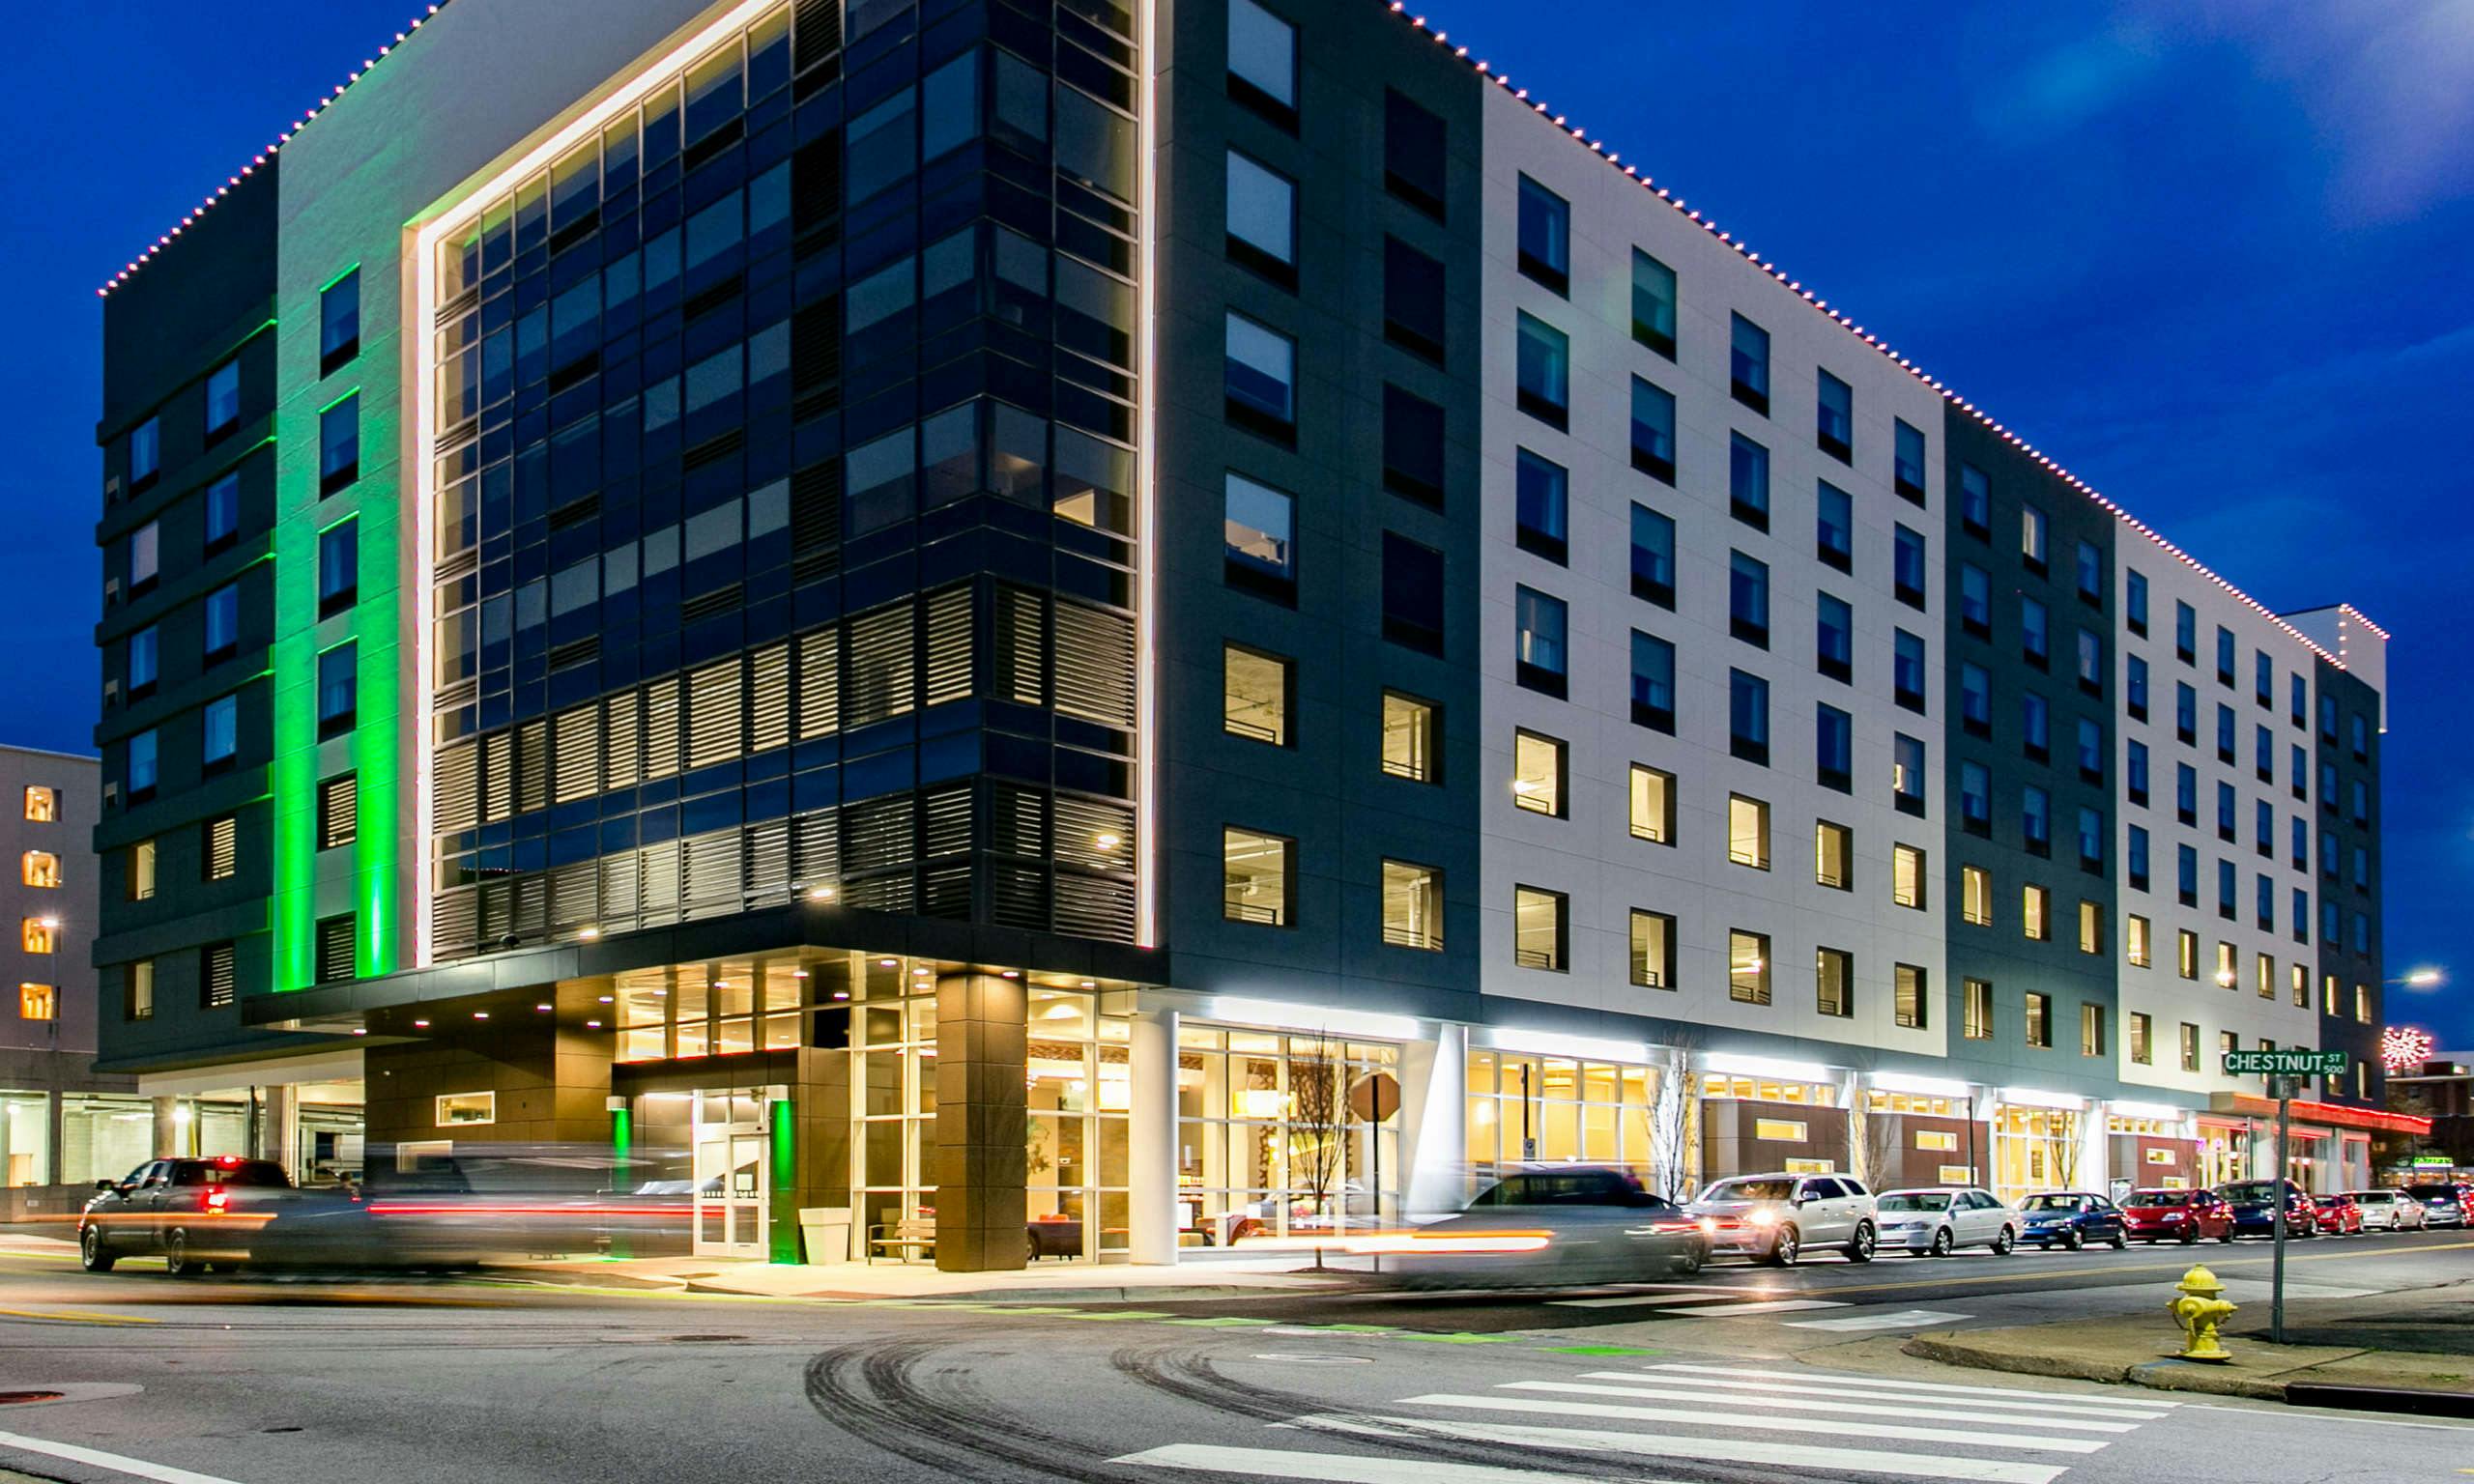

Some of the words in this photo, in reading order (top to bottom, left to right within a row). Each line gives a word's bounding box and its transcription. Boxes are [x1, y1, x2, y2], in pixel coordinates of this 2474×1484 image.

[2225, 1053, 2324, 1071] CHESTNUT
[2327, 1053, 2342, 1063] ST
[2323, 1065, 2345, 1074] 500
